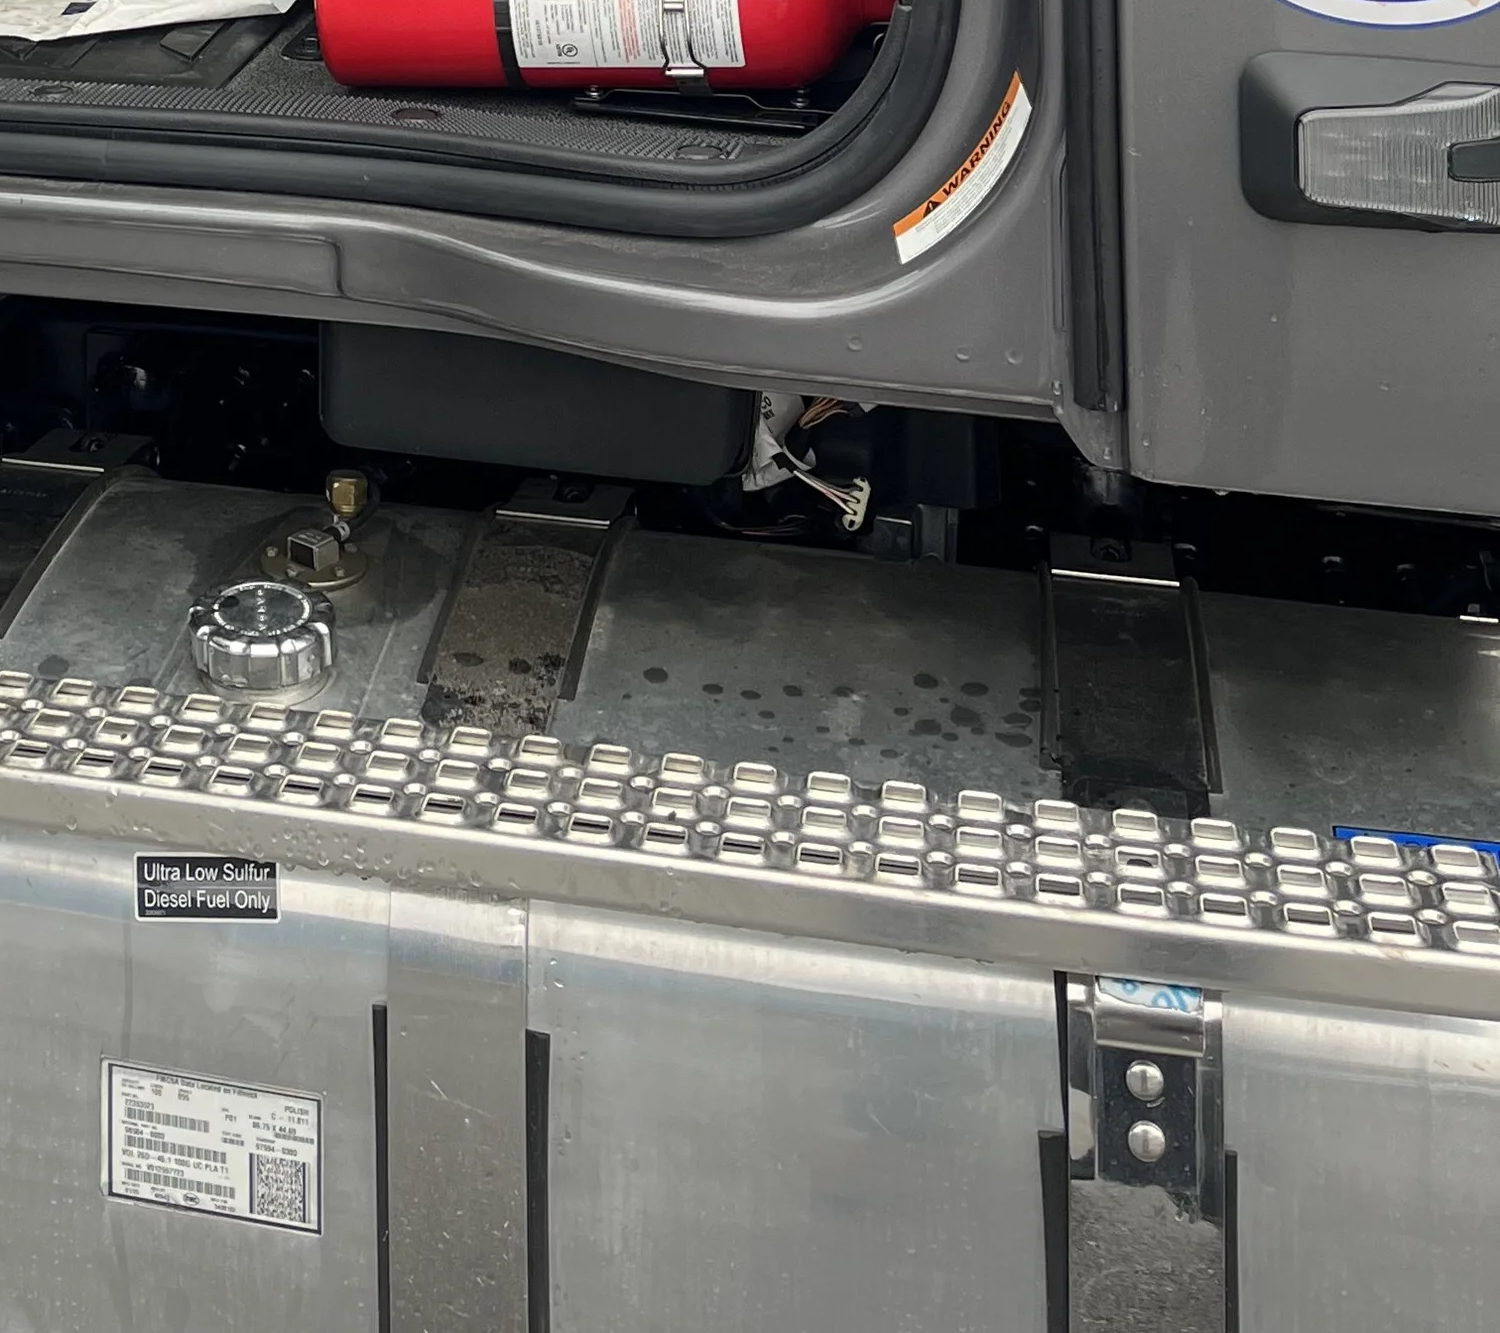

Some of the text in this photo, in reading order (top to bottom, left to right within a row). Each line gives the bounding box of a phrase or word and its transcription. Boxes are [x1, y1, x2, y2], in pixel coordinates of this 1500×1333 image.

[943, 101, 1011, 198] WARNING
[144, 863, 270, 881] Ultra Low Sulfur
[144, 889, 270, 913] Diesel Fuel Only
